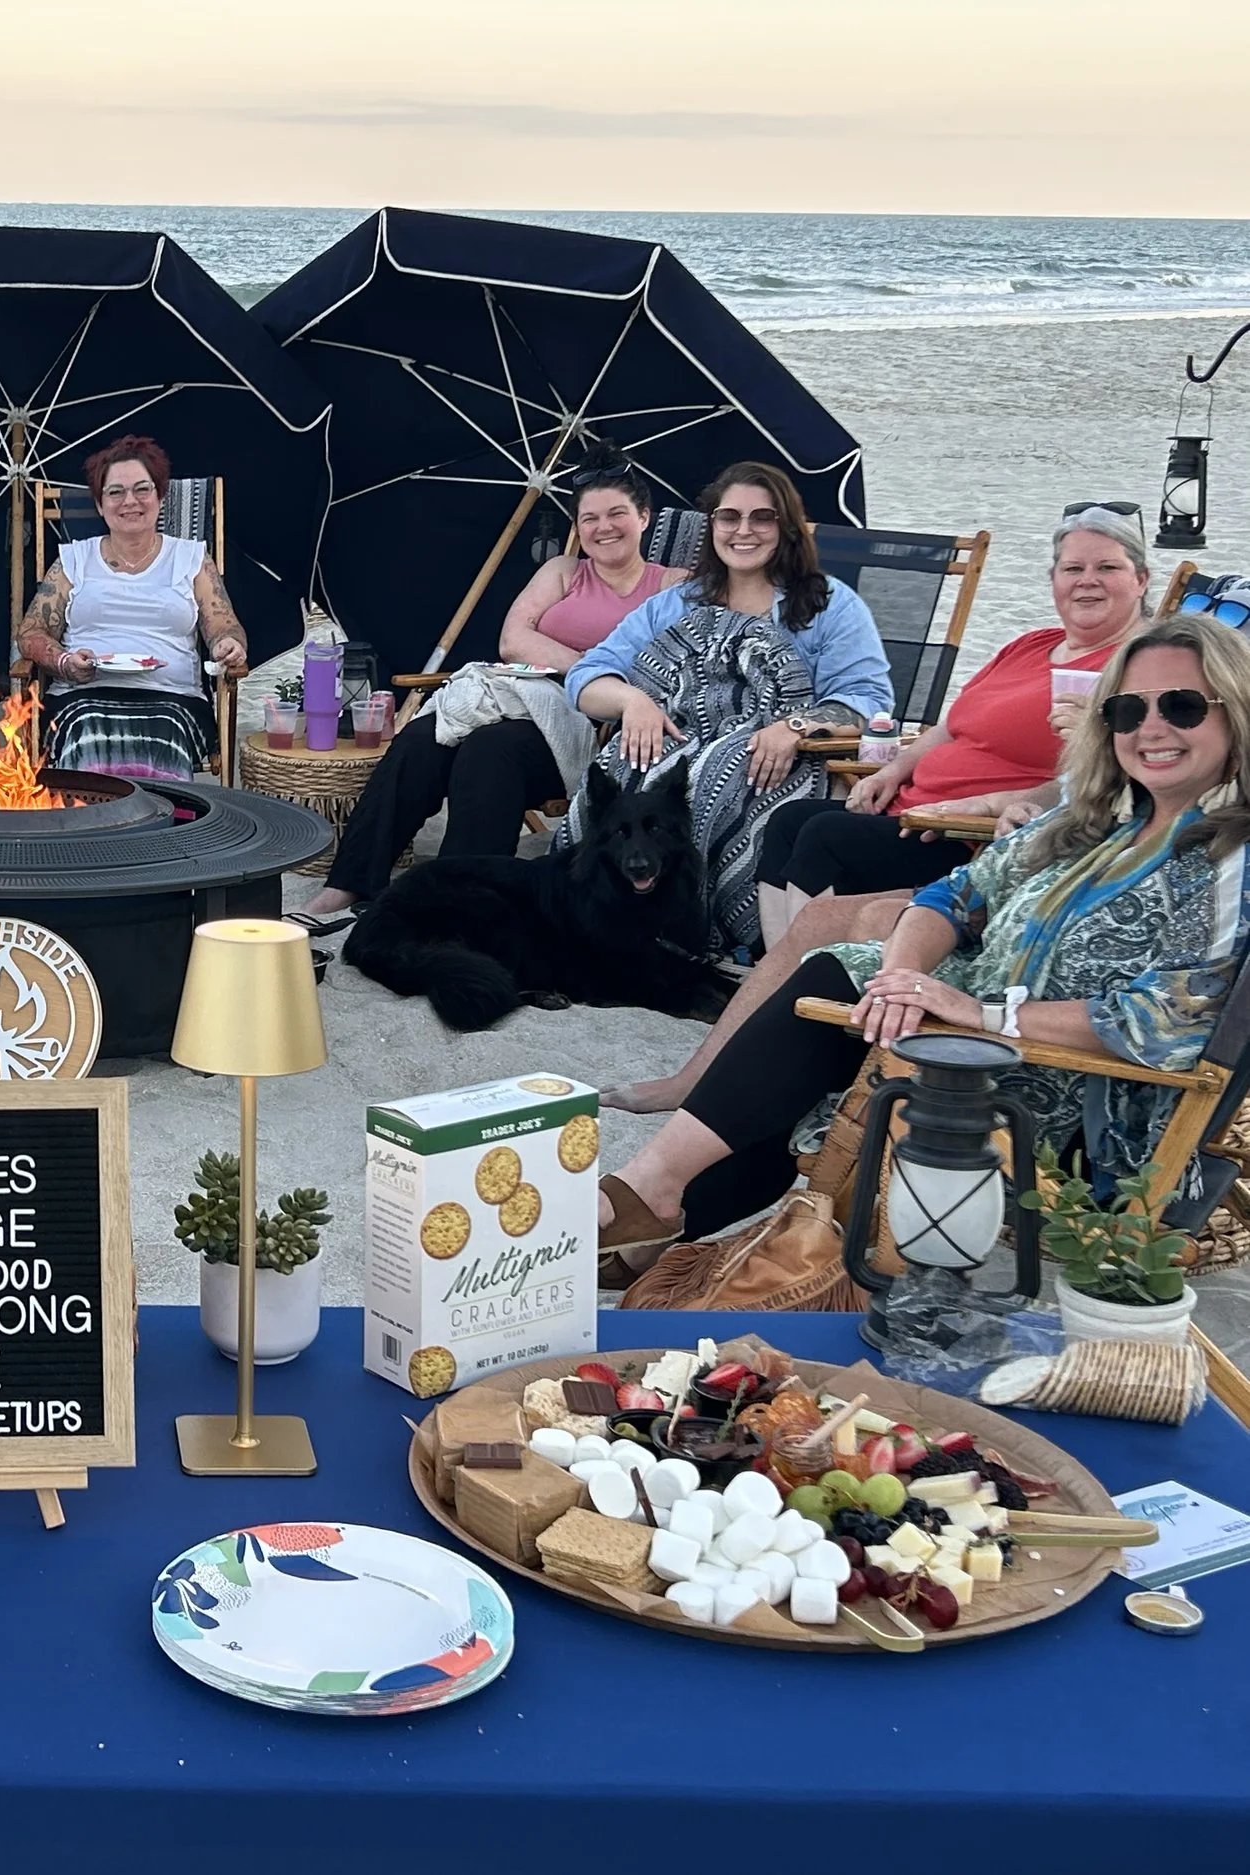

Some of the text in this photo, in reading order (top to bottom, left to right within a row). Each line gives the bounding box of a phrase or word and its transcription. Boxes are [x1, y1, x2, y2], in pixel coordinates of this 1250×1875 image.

[481, 1123, 516, 1140] TRADER
[442, 1230, 579, 1304] Multigrain
[451, 1281, 576, 1328] CRACKERS
